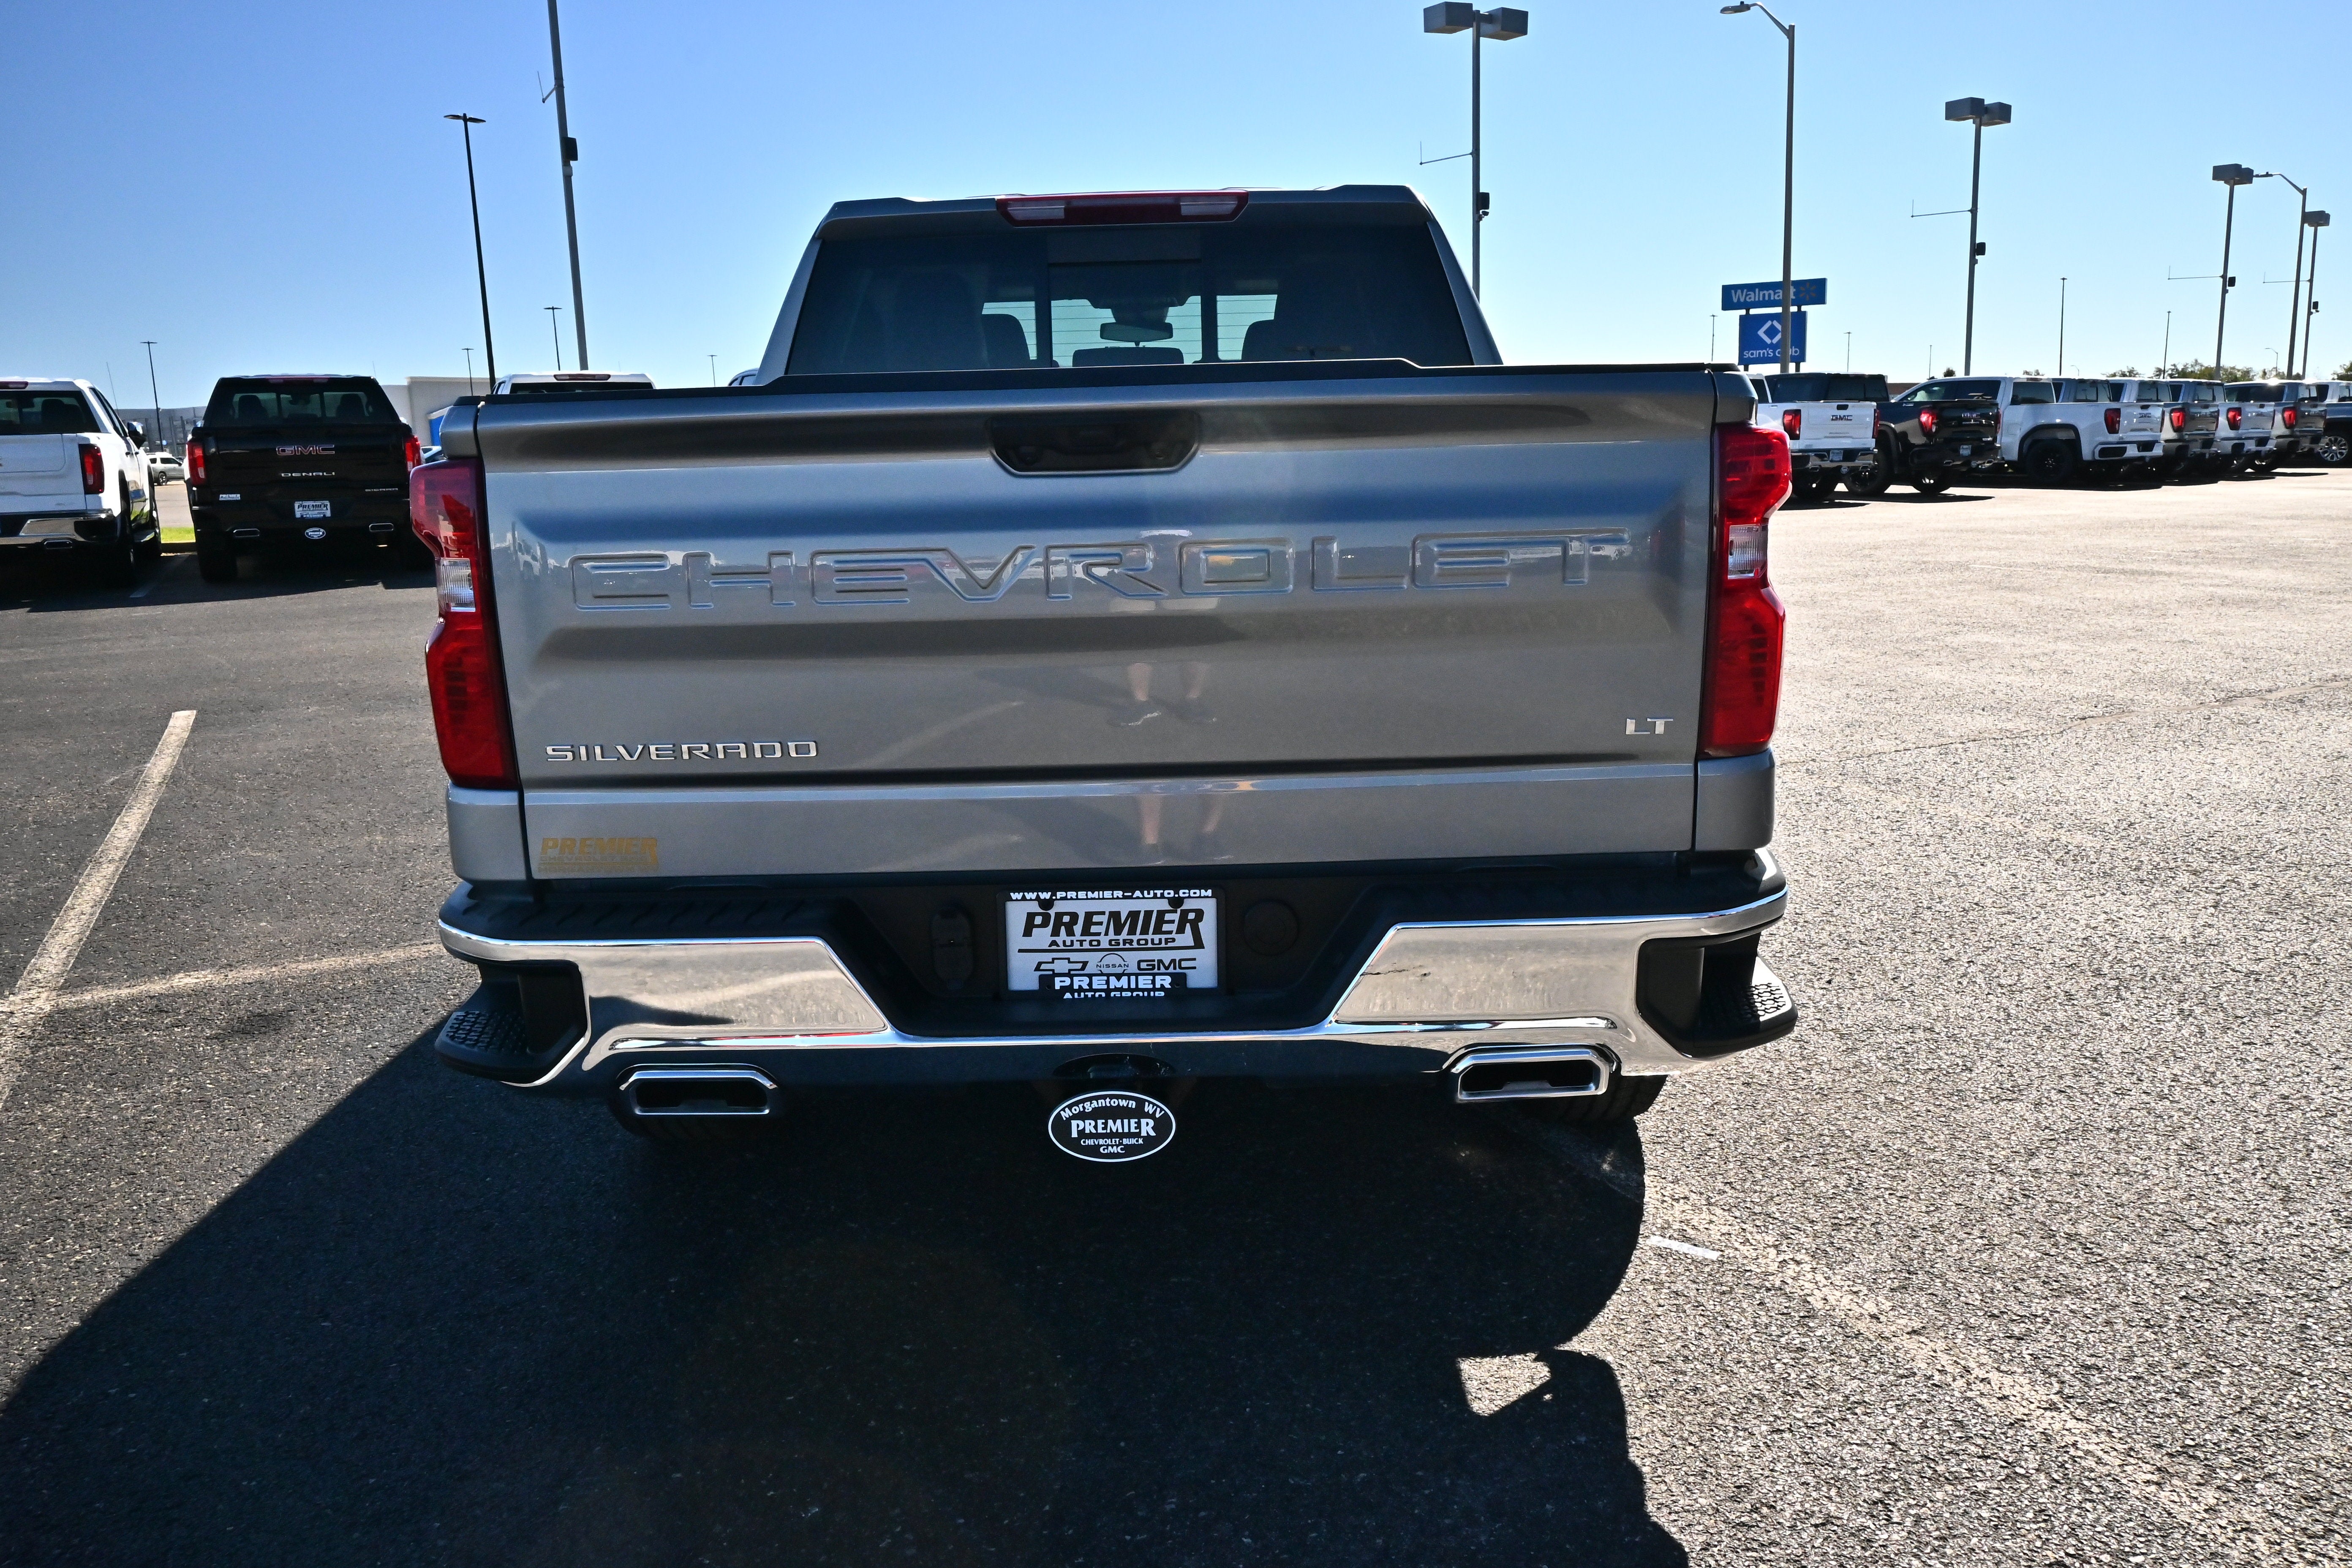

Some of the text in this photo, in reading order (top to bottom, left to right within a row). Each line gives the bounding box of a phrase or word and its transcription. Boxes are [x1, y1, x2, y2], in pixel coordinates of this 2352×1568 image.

[1731, 286, 1796, 302] Walmat
[1743, 348, 1773, 358] sam's
[276, 444, 335, 456] GMC
[570, 528, 1630, 610] CHEVROLET
[1625, 717, 1674, 735] LT
[545, 740, 819, 761] SILVERADO
[541, 837, 658, 865] PREMIER
[1010, 889, 1212, 900] WWW.PREMIER-AUTO.COM
[1022, 908, 1205, 949] PREMIER
[1048, 937, 1176, 947] AUTO GROUP
[1137, 958, 1197, 971] GMC
[1054, 975, 1172, 990] PREMIER
[1060, 1097, 1165, 1121] Morgantown WV
[1070, 1118, 1157, 1138] PREMIER
[1100, 1146, 1126, 1154] GMC
